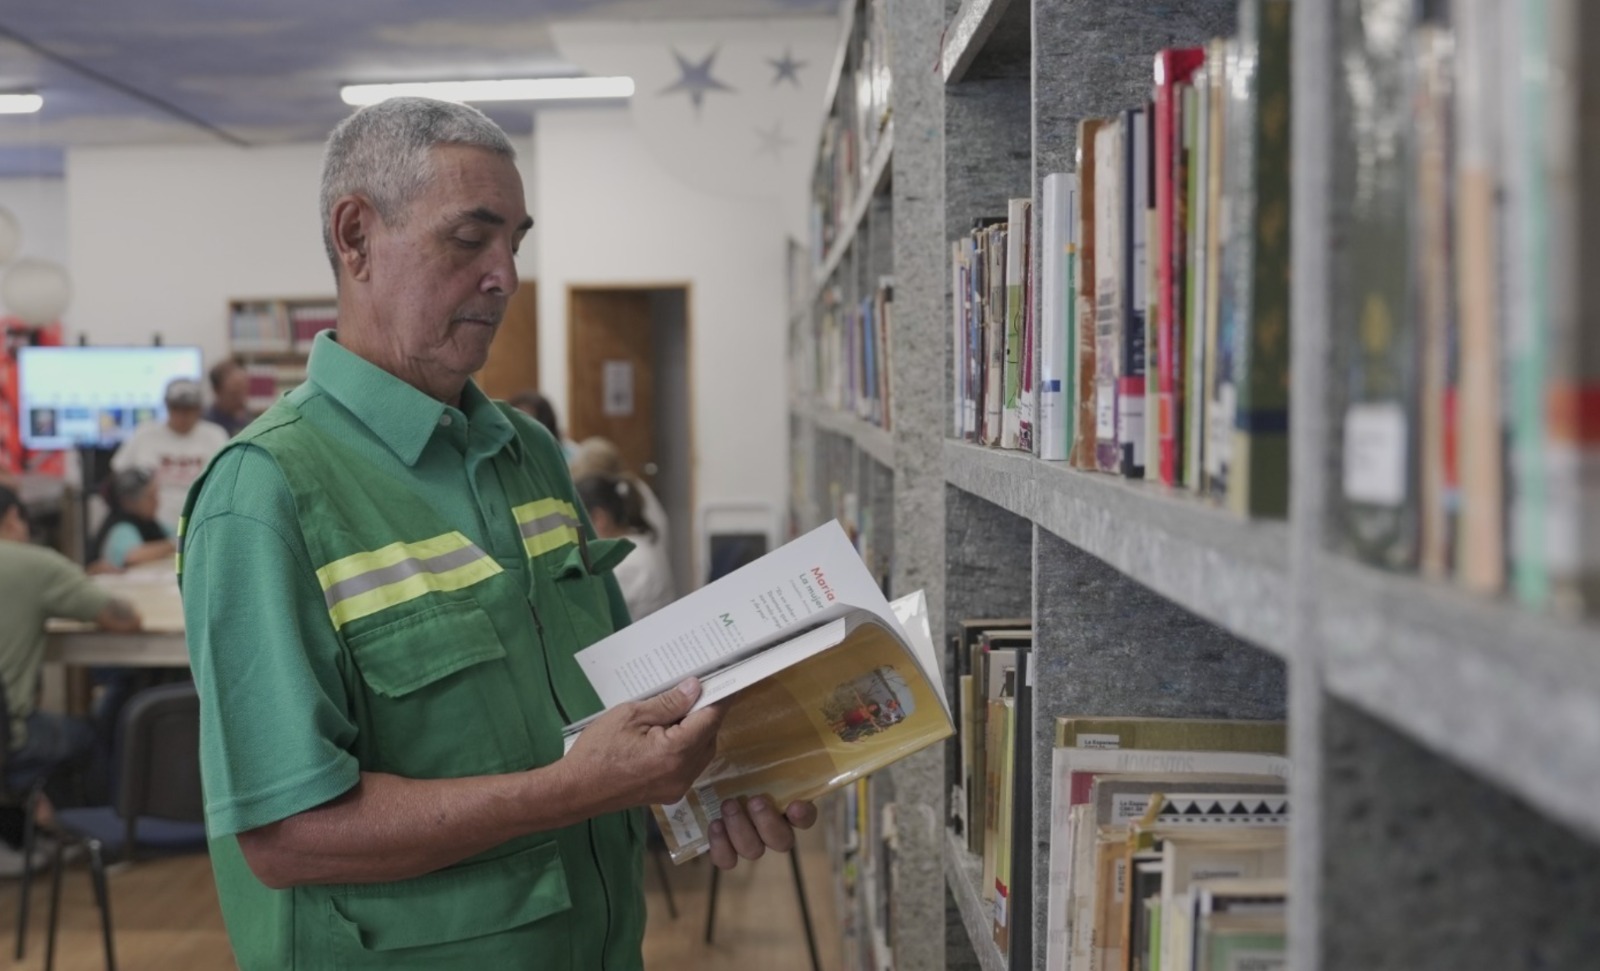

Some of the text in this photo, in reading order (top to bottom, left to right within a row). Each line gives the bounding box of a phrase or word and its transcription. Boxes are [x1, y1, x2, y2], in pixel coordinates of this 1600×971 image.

[799, 574, 808, 584] La
[806, 585, 824, 608] mujer
[811, 567, 834, 601] María
